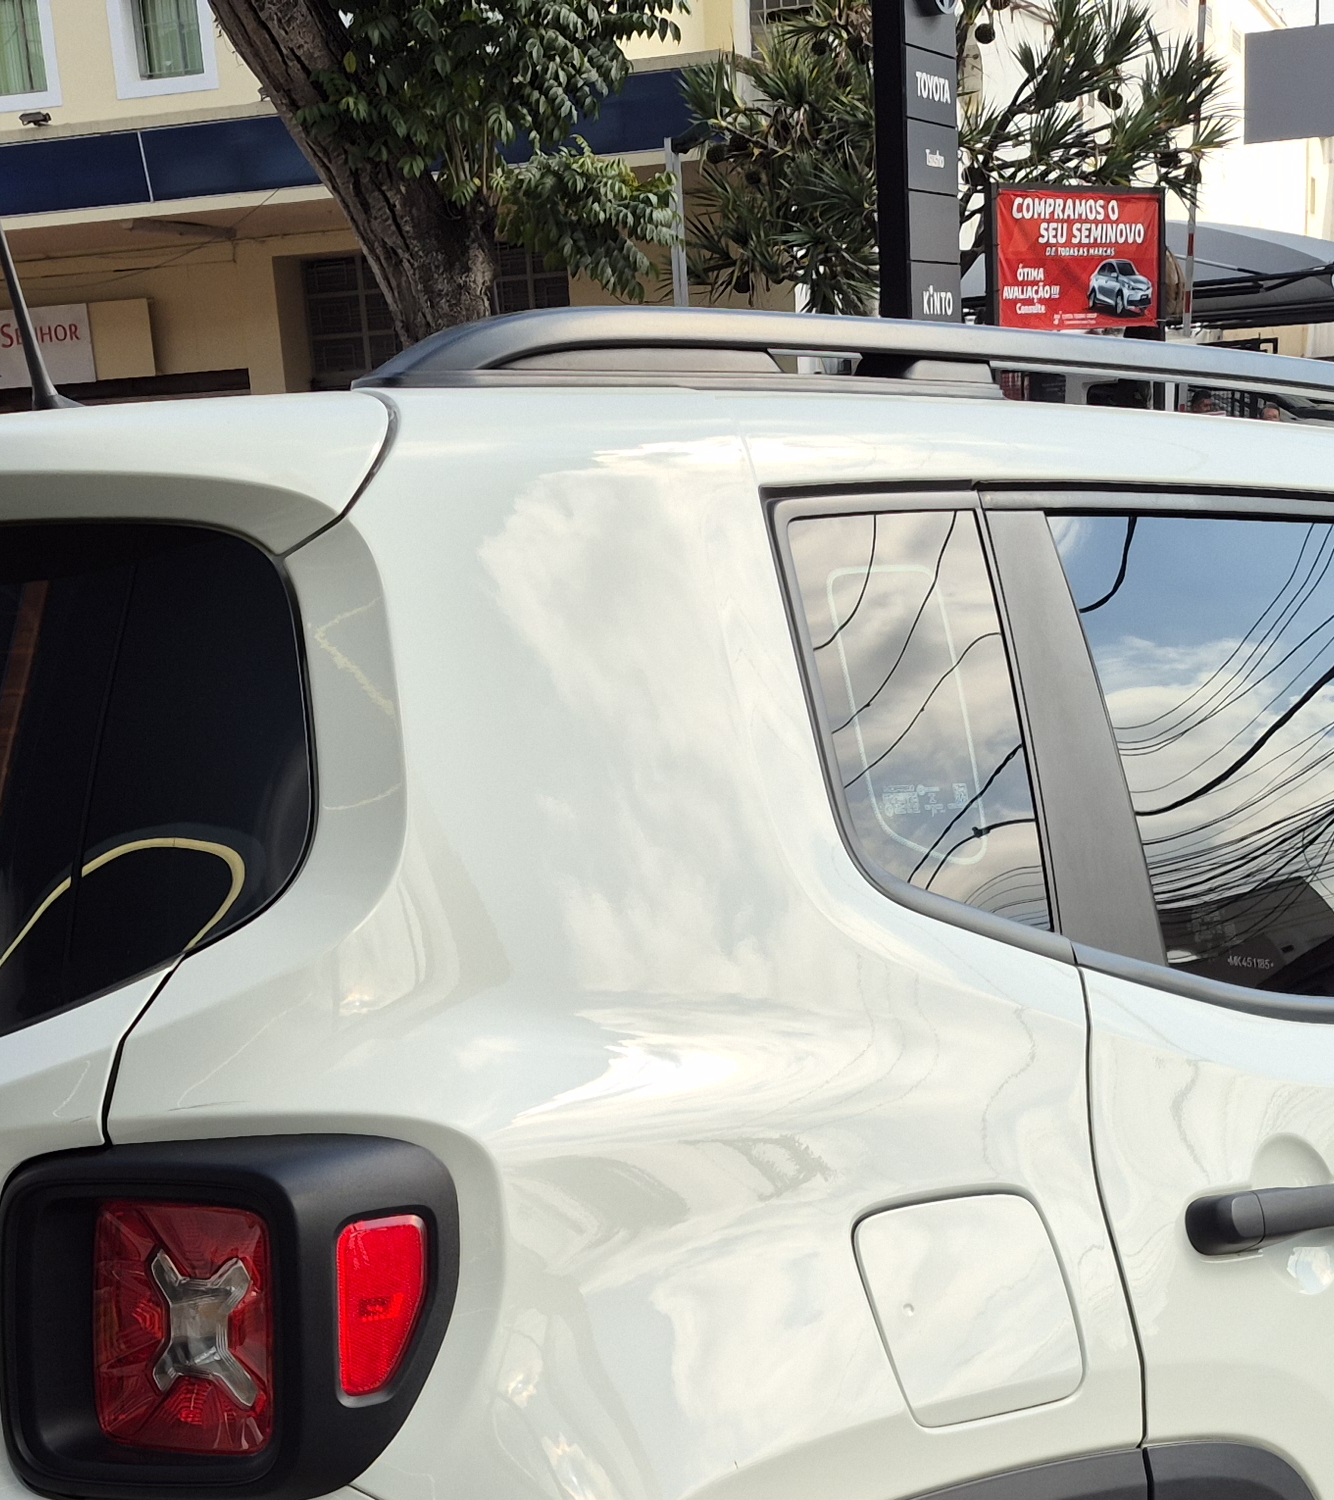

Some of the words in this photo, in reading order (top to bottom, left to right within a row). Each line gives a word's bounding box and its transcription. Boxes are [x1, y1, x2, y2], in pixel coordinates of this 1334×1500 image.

[916, 71, 950, 104] TOYOTA
[1012, 197, 1105, 221] COMPRAMOS
[1109, 200, 1118, 220] O
[1038, 222, 1067, 244] SEU
[1072, 223, 1145, 245] SEMINOVO
[1045, 247, 1056, 256] DE
[1089, 247, 1115, 256] MARCAS
[1017, 264, 1044, 281] ÓTIMA
[1016, 303, 1046, 314] Consulte
[0, 322, 81, 348] SEHOR
